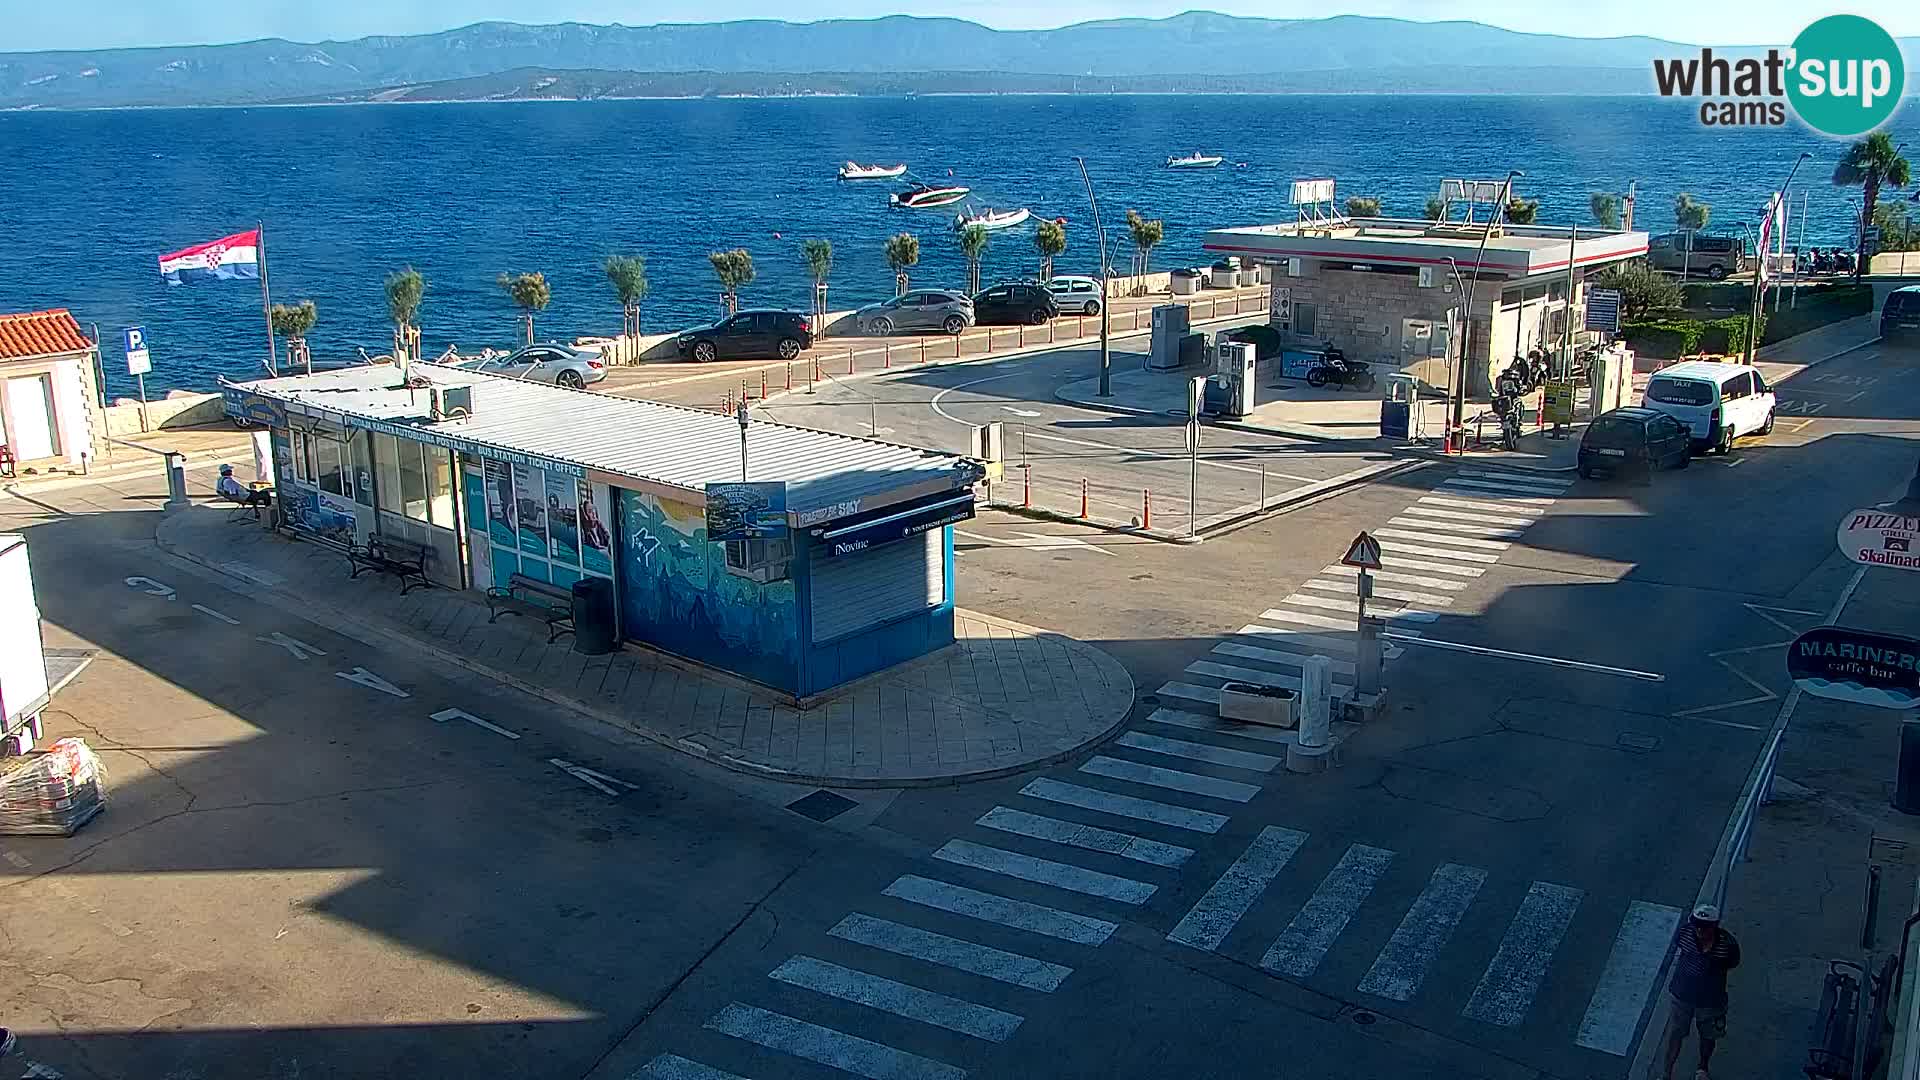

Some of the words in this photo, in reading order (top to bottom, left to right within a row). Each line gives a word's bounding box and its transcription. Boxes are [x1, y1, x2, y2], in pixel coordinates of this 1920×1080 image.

[128, 330, 142, 350] P
[1673, 380, 1691, 388] TAXI
[1777, 400, 1828, 414] AXI
[395, 427, 435, 444] AUTOBUSNA
[436, 436, 467, 451] POSTAJA
[478, 445, 492, 457] BUS
[493, 450, 526, 464] STATION
[528, 457, 554, 470] TICKET
[555, 463, 582, 476] OFFICE
[951, 511, 969, 521] CHOICE
[1881, 529, 1916, 539] GRILL
[1827, 661, 1865, 674] caffe
[1870, 664, 1896, 680] bar
